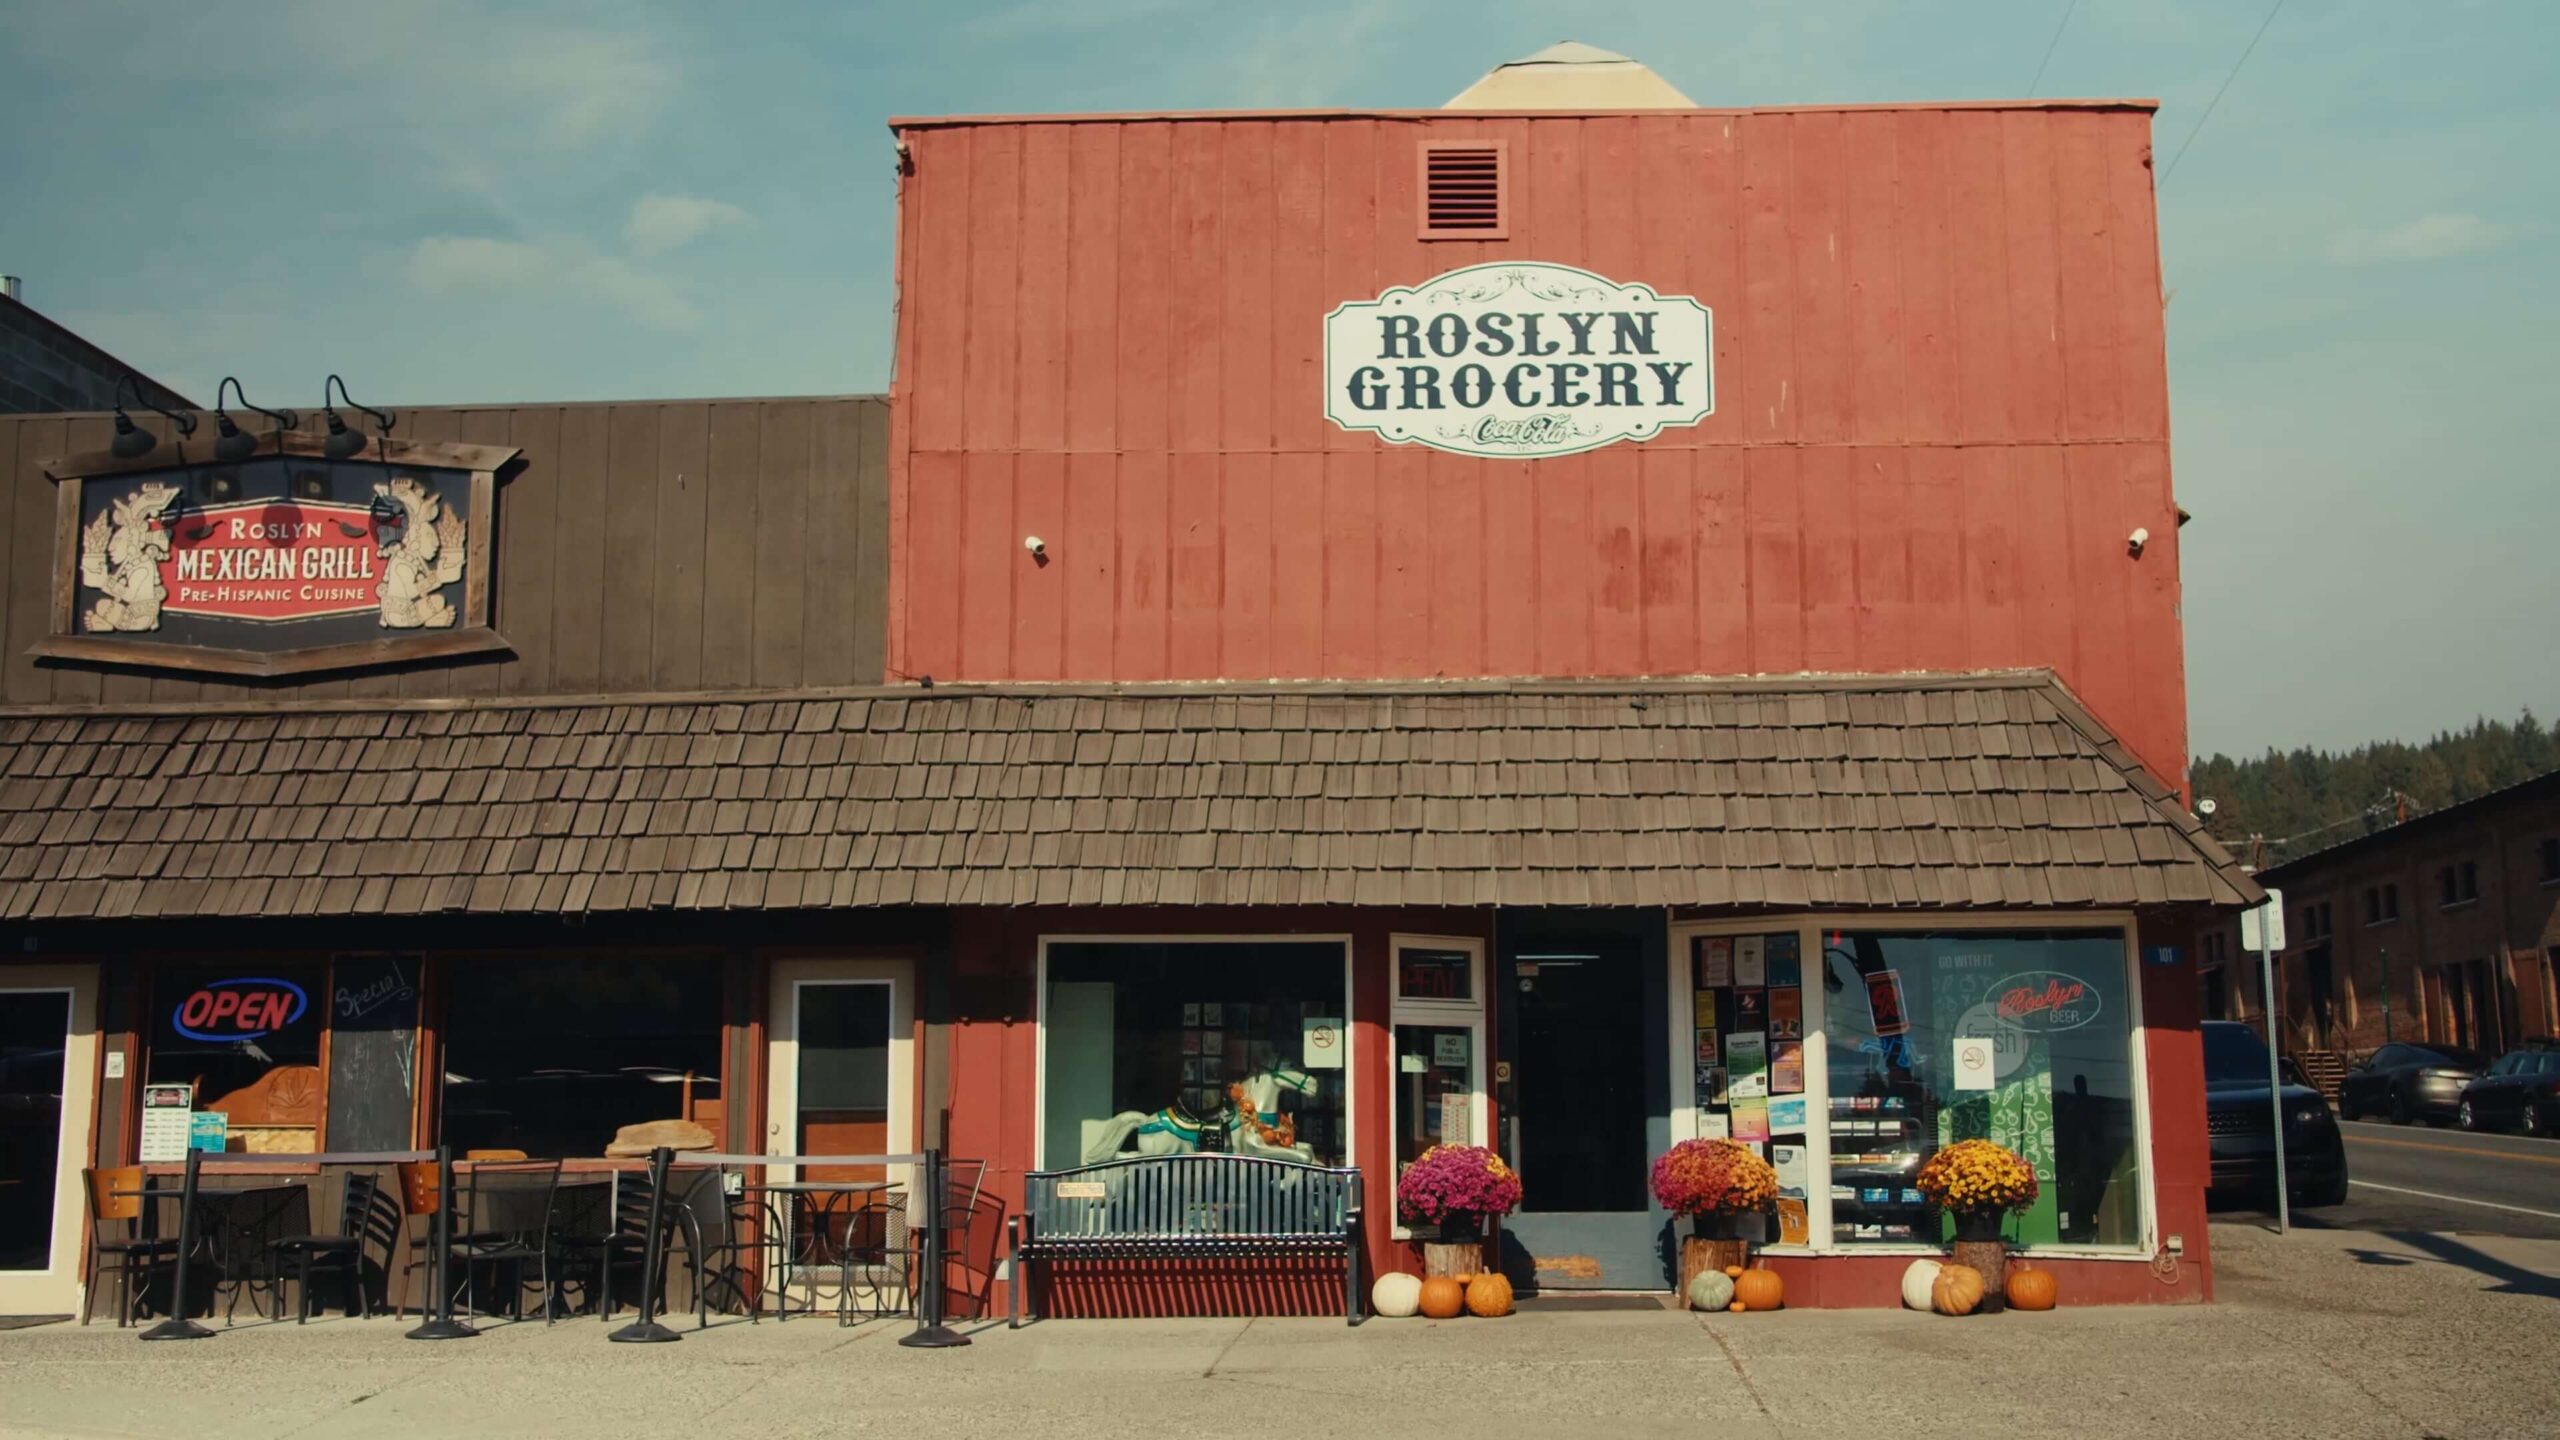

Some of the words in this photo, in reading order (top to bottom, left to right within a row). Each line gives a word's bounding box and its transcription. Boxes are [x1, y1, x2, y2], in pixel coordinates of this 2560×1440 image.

[1376, 311, 1659, 359] ROSLYN
[1346, 361, 1693, 410] GROCERY
[1472, 413, 1571, 446] Coca-Cola
[177, 548, 296, 581] MEXICAN
[302, 546, 374, 580] GRILL
[1954, 953, 1981, 968] WITH
[2158, 946, 2174, 963] 101
[180, 990, 294, 1031] OPEN
[1998, 979, 2085, 1018] Roslyn
[2049, 1010, 2080, 1023] BEER
[1445, 1038, 1457, 1046] NO
[1967, 1023, 2016, 1053] fsh
